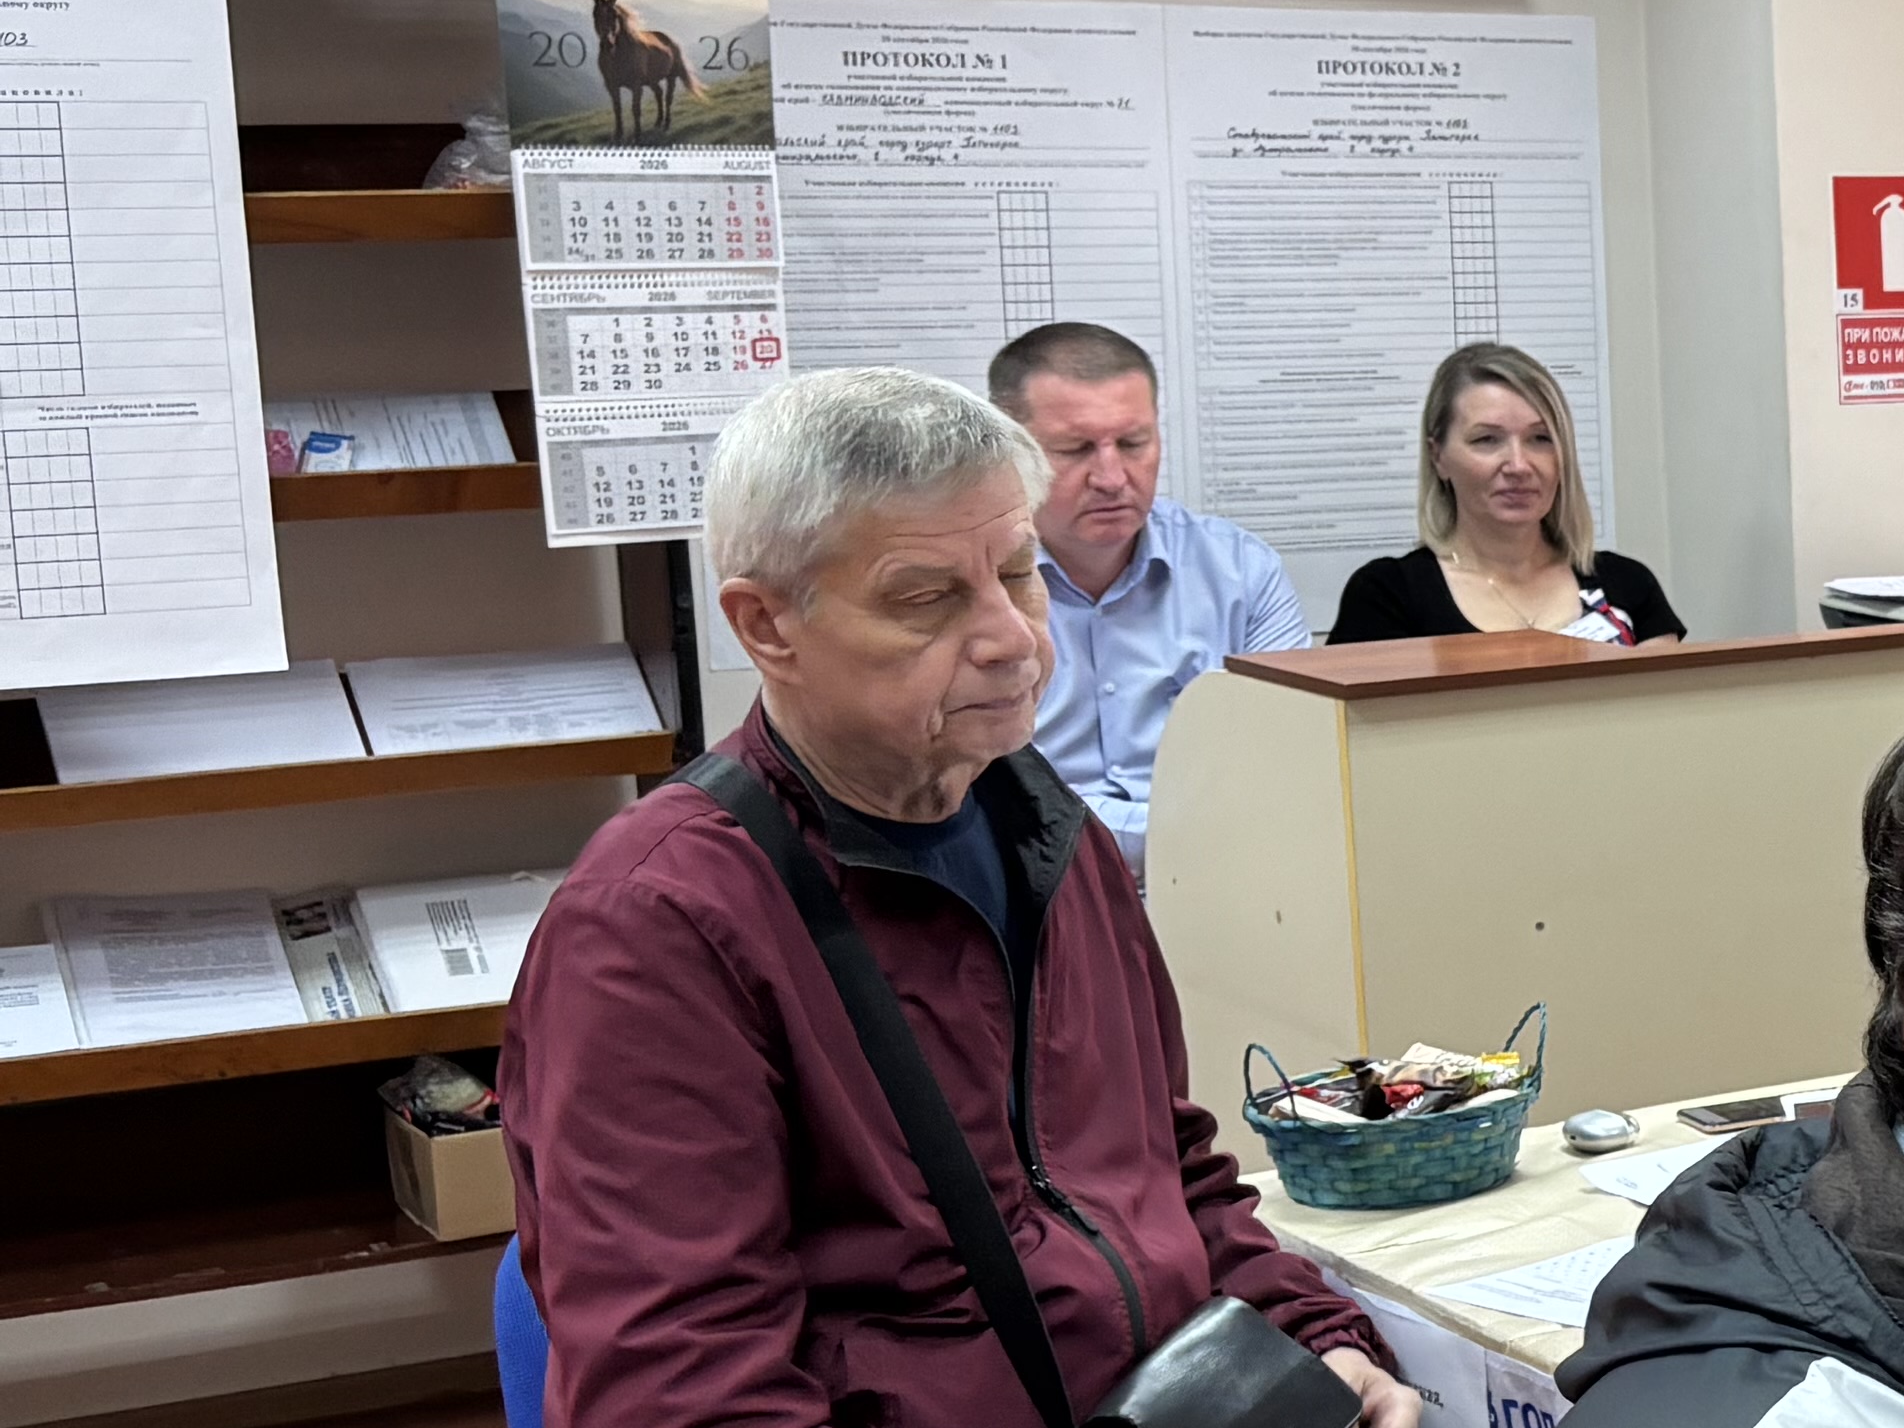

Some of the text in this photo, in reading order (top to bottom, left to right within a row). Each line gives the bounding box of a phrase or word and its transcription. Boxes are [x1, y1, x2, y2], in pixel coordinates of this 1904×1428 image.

[527, 31, 749, 71] 20 26
[842, 50, 1008, 70] ПРОТОКОЛ № 1
[1317, 60, 1461, 77] ПРОТОКОЛ № 2
[522, 159, 771, 171] АВГУСТ 2026 AUGUST
[727, 185, 764, 196] 1 2
[572, 201, 582, 212] 3
[604, 201, 615, 212] 4
[668, 201, 677, 211] 6
[698, 201, 707, 211] 7
[569, 217, 588, 228] 10
[602, 217, 620, 228] 11
[635, 216, 652, 227] 12
[664, 216, 683, 227] 13
[696, 216, 713, 227] 14
[570, 232, 771, 244] 17 18 19 20 21 22 23
[604, 248, 623, 260] 25
[636, 248, 654, 260] 26
[667, 248, 684, 259] 27
[698, 248, 715, 259] 28
[756, 248, 773, 258] 30
[1842, 293, 1859, 309] 15
[613, 317, 620, 328] 1
[643, 317, 653, 327] 2
[704, 315, 714, 326] 4
[580, 333, 590, 345] 7
[672, 331, 689, 342] 10
[702, 330, 718, 341] 11
[730, 330, 746, 341] 12
[1844, 327, 1870, 344] ПРИ
[576, 349, 596, 361] 14
[610, 348, 629, 360] 15
[642, 348, 661, 359] 16
[673, 347, 690, 358] 17
[703, 346, 720, 357] 18
[577, 365, 597, 376] 21
[611, 364, 630, 375] 22
[643, 363, 662, 374] 23
[703, 361, 721, 372] 25
[580, 379, 663, 392] 28 29 30
[546, 425, 610, 438] ОКТЯБРЬ
